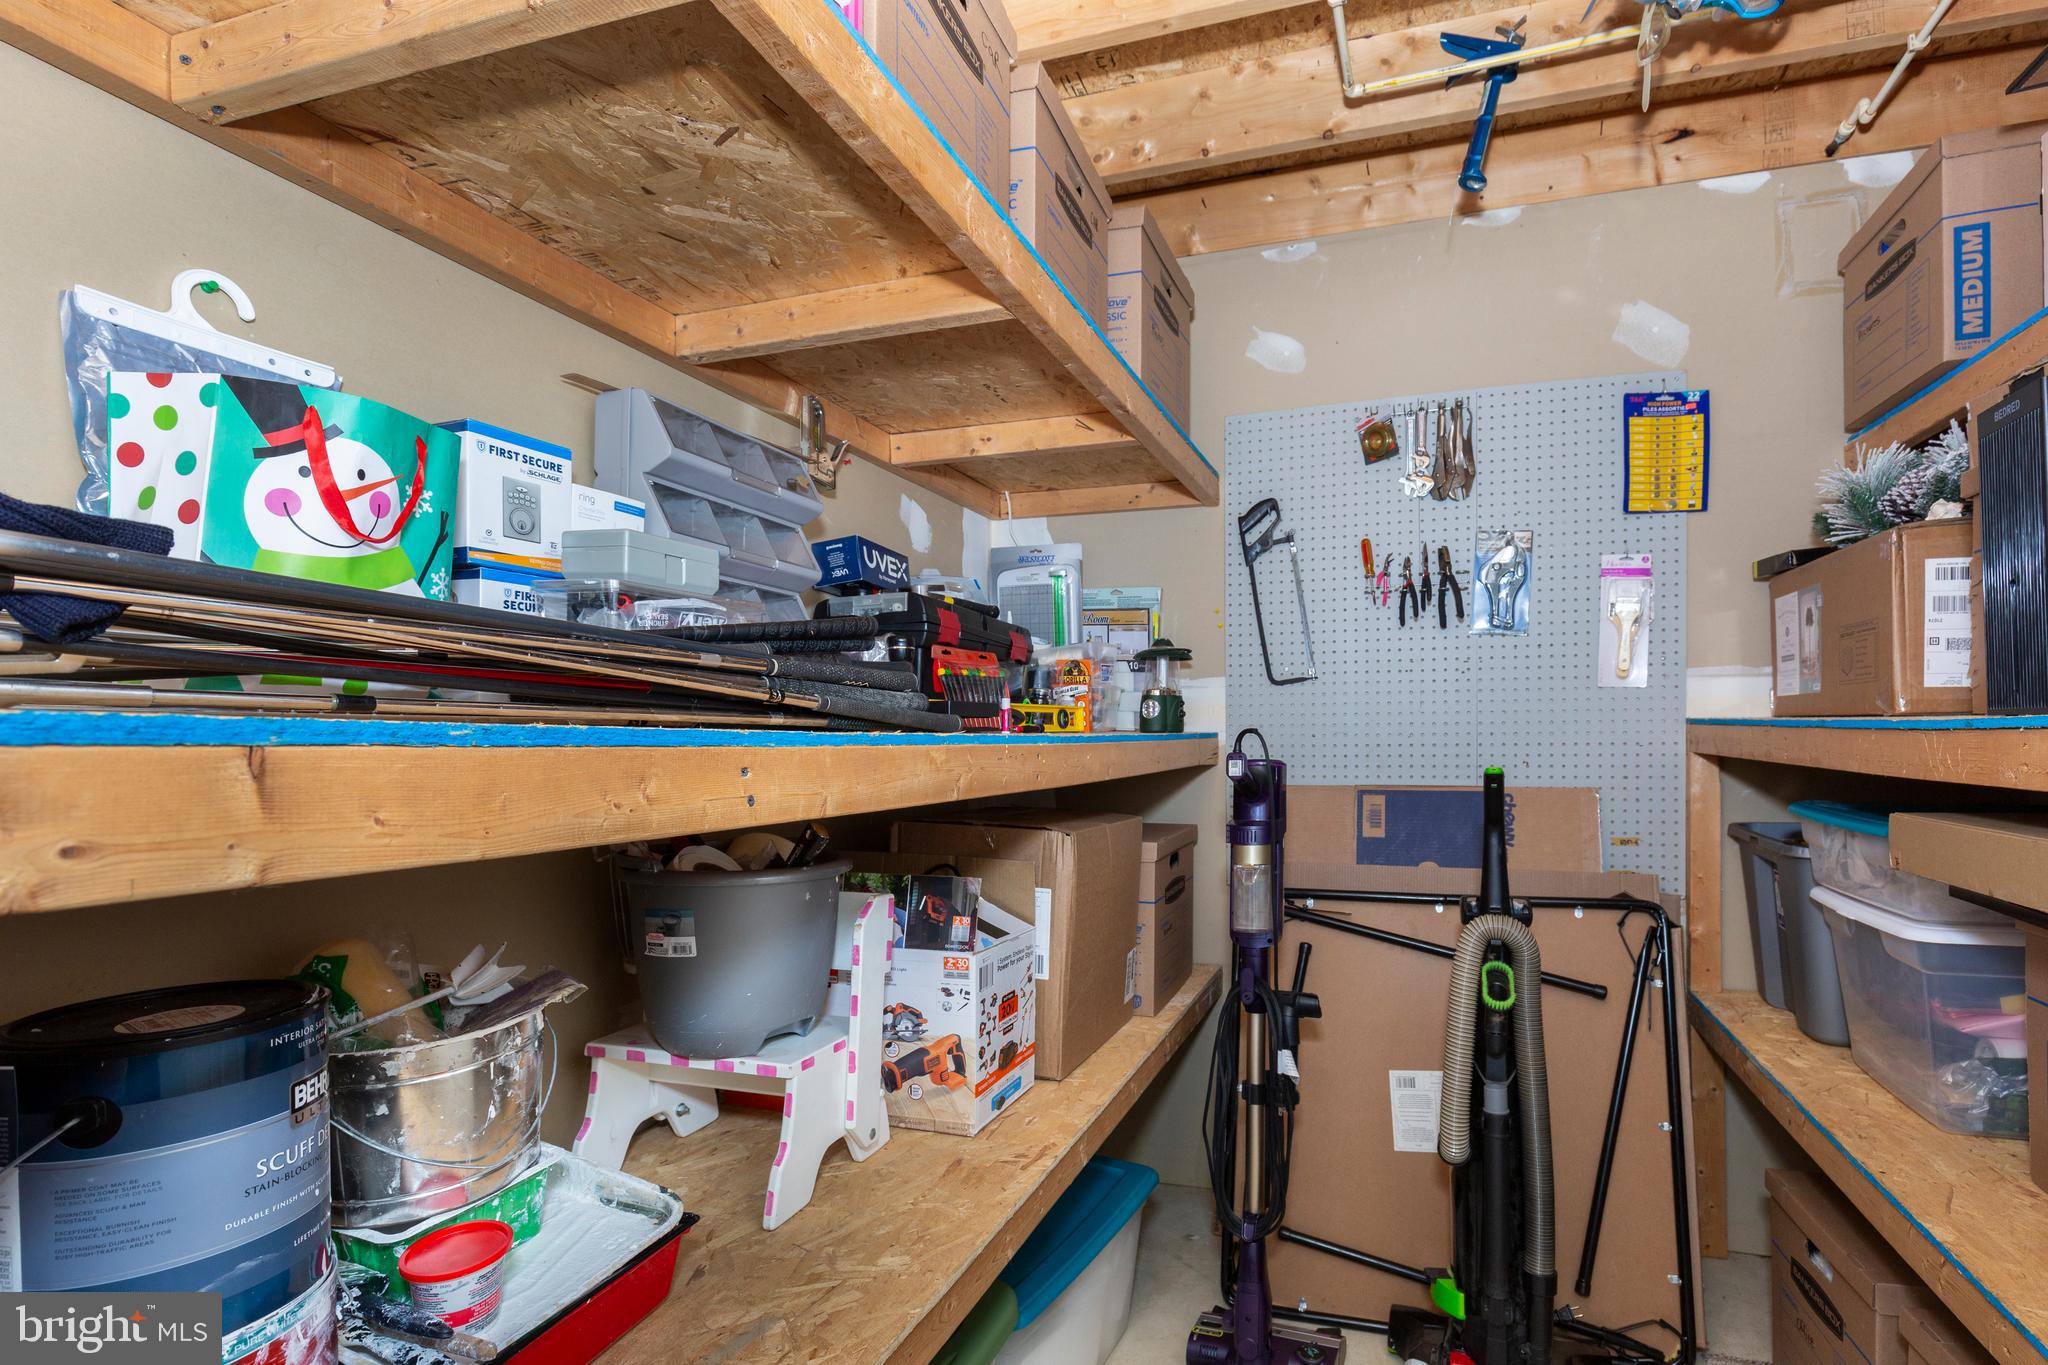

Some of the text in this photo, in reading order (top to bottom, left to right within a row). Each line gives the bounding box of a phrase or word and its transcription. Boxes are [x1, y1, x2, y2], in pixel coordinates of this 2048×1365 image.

[1962, 228, 1984, 335] MEDIUM
[1994, 399, 2021, 422] BEDRED
[488, 444, 563, 474] FIRST SECURE
[578, 493, 596, 506] ring
[863, 545, 908, 583] UVEX
[1129, 661, 1139, 670] 10
[270, 1024, 315, 1048] INTERIOR
[256, 1135, 314, 1178] SCUFF
[60, 1187, 88, 1195] PRIMER
[88, 1184, 109, 1192] COAT
[110, 1181, 127, 1190] MAY
[97, 1189, 120, 1197] SOME
[121, 1180, 162, 1193] SURFACES
[54, 1210, 94, 1219] ADVANCED
[95, 1206, 120, 1214] SCUFF
[225, 1208, 270, 1231] DURABLE
[272, 1194, 298, 1213] FINISH
[300, 1186, 315, 1199] WITH
[54, 1216, 97, 1225] RESISTANCE
[54, 1219, 141, 1237] EXCEPTIONAL BURNISH
[151, 1217, 177, 1227] FINISH
[54, 1242, 107, 1255] OUTSTANDING
[108, 1233, 154, 1248] DURABILITY
[54, 1253, 74, 1261] BUSY
[129, 1239, 155, 1250] AREAS
[234, 1333, 266, 1354] PURE
